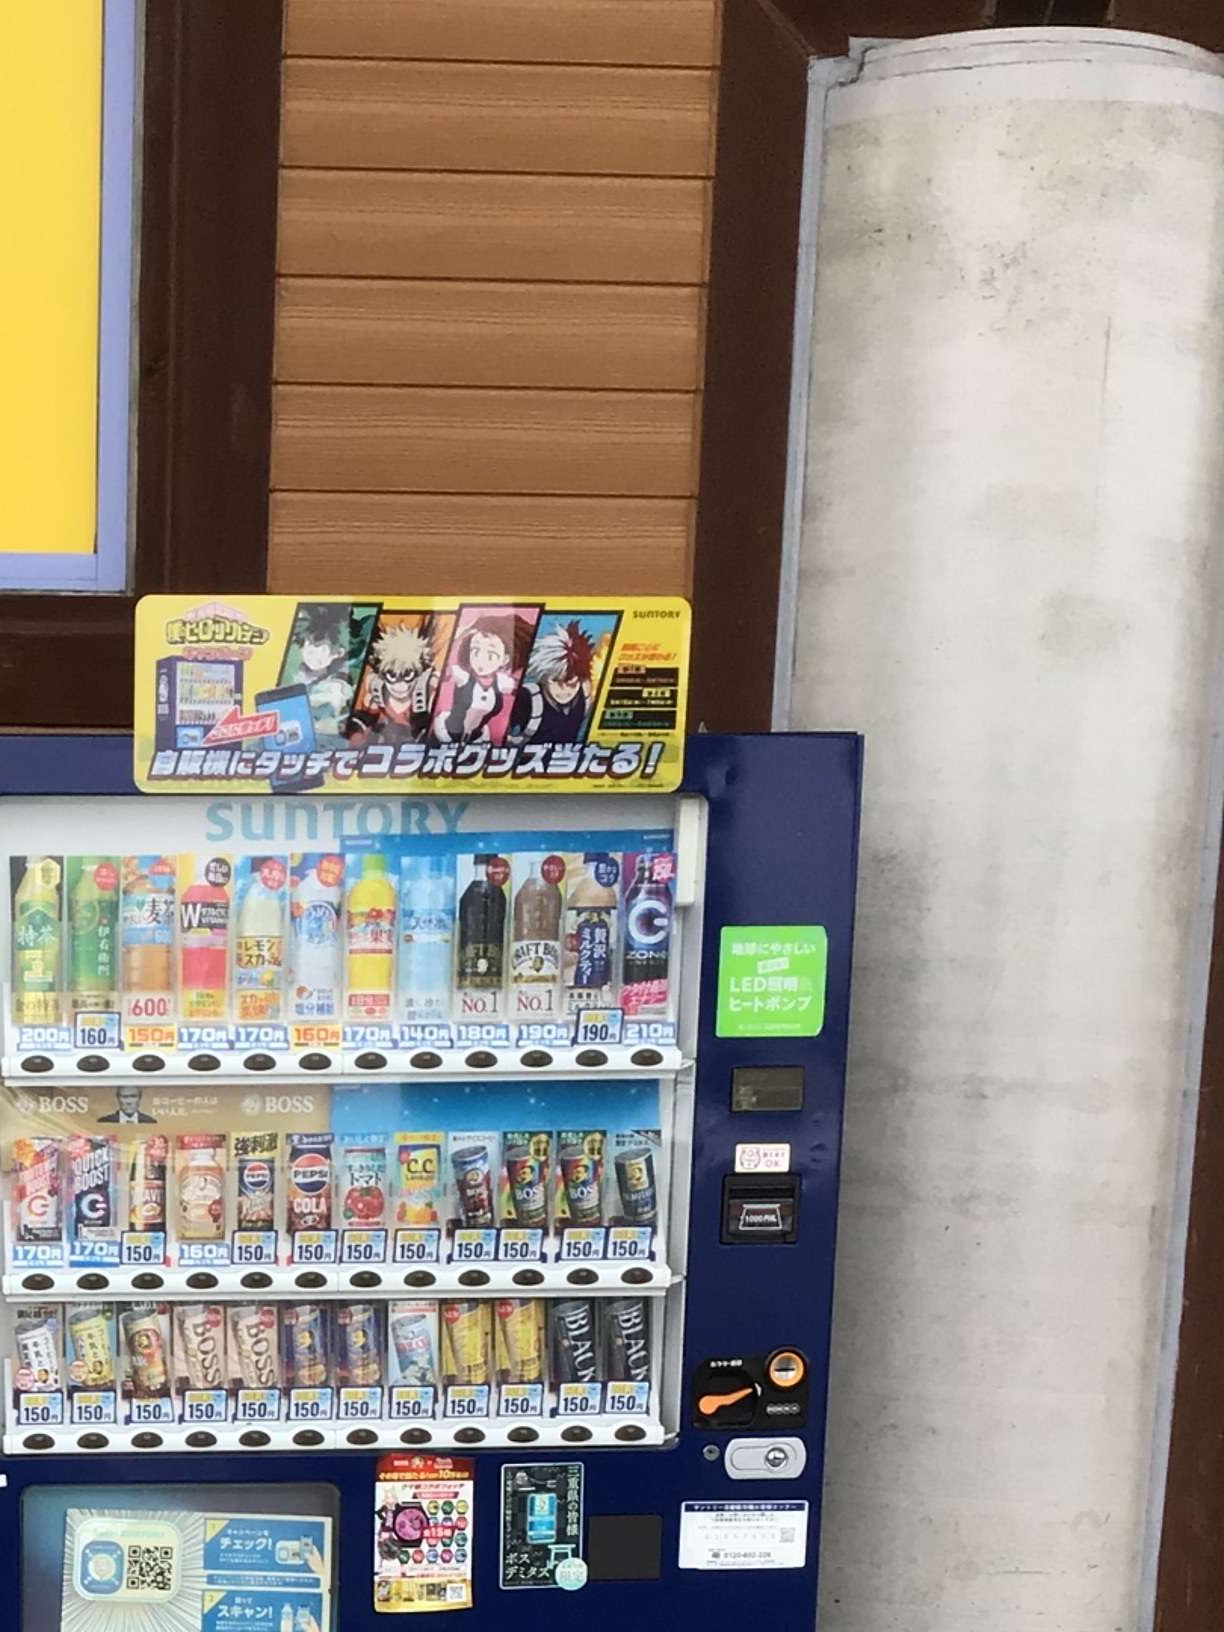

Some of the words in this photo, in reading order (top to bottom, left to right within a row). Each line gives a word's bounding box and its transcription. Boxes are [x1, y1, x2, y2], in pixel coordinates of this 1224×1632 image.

[18, 925, 57, 948] 特茶
[131, 997, 167, 1017] 600
[38, 1096, 89, 1114] BOSS
[264, 1096, 315, 1113] BOSS
[293, 1169, 329, 1179] PEPSI
[349, 1173, 383, 1187] トマト
[293, 1197, 328, 1214] COLA
[564, 1305, 596, 1382] BLACK
[618, 1301, 650, 1381] BLACK
[192, 1322, 222, 1384] BOSS
[246, 1322, 276, 1386] BOSS
[566, 1466, 580, 1536] 三重県の皆様
[219, 1536, 273, 1551] チェック!
[505, 1553, 531, 1564] ボス
[505, 1566, 550, 1580] デミタス
[217, 1605, 273, 1619] スキャン!
